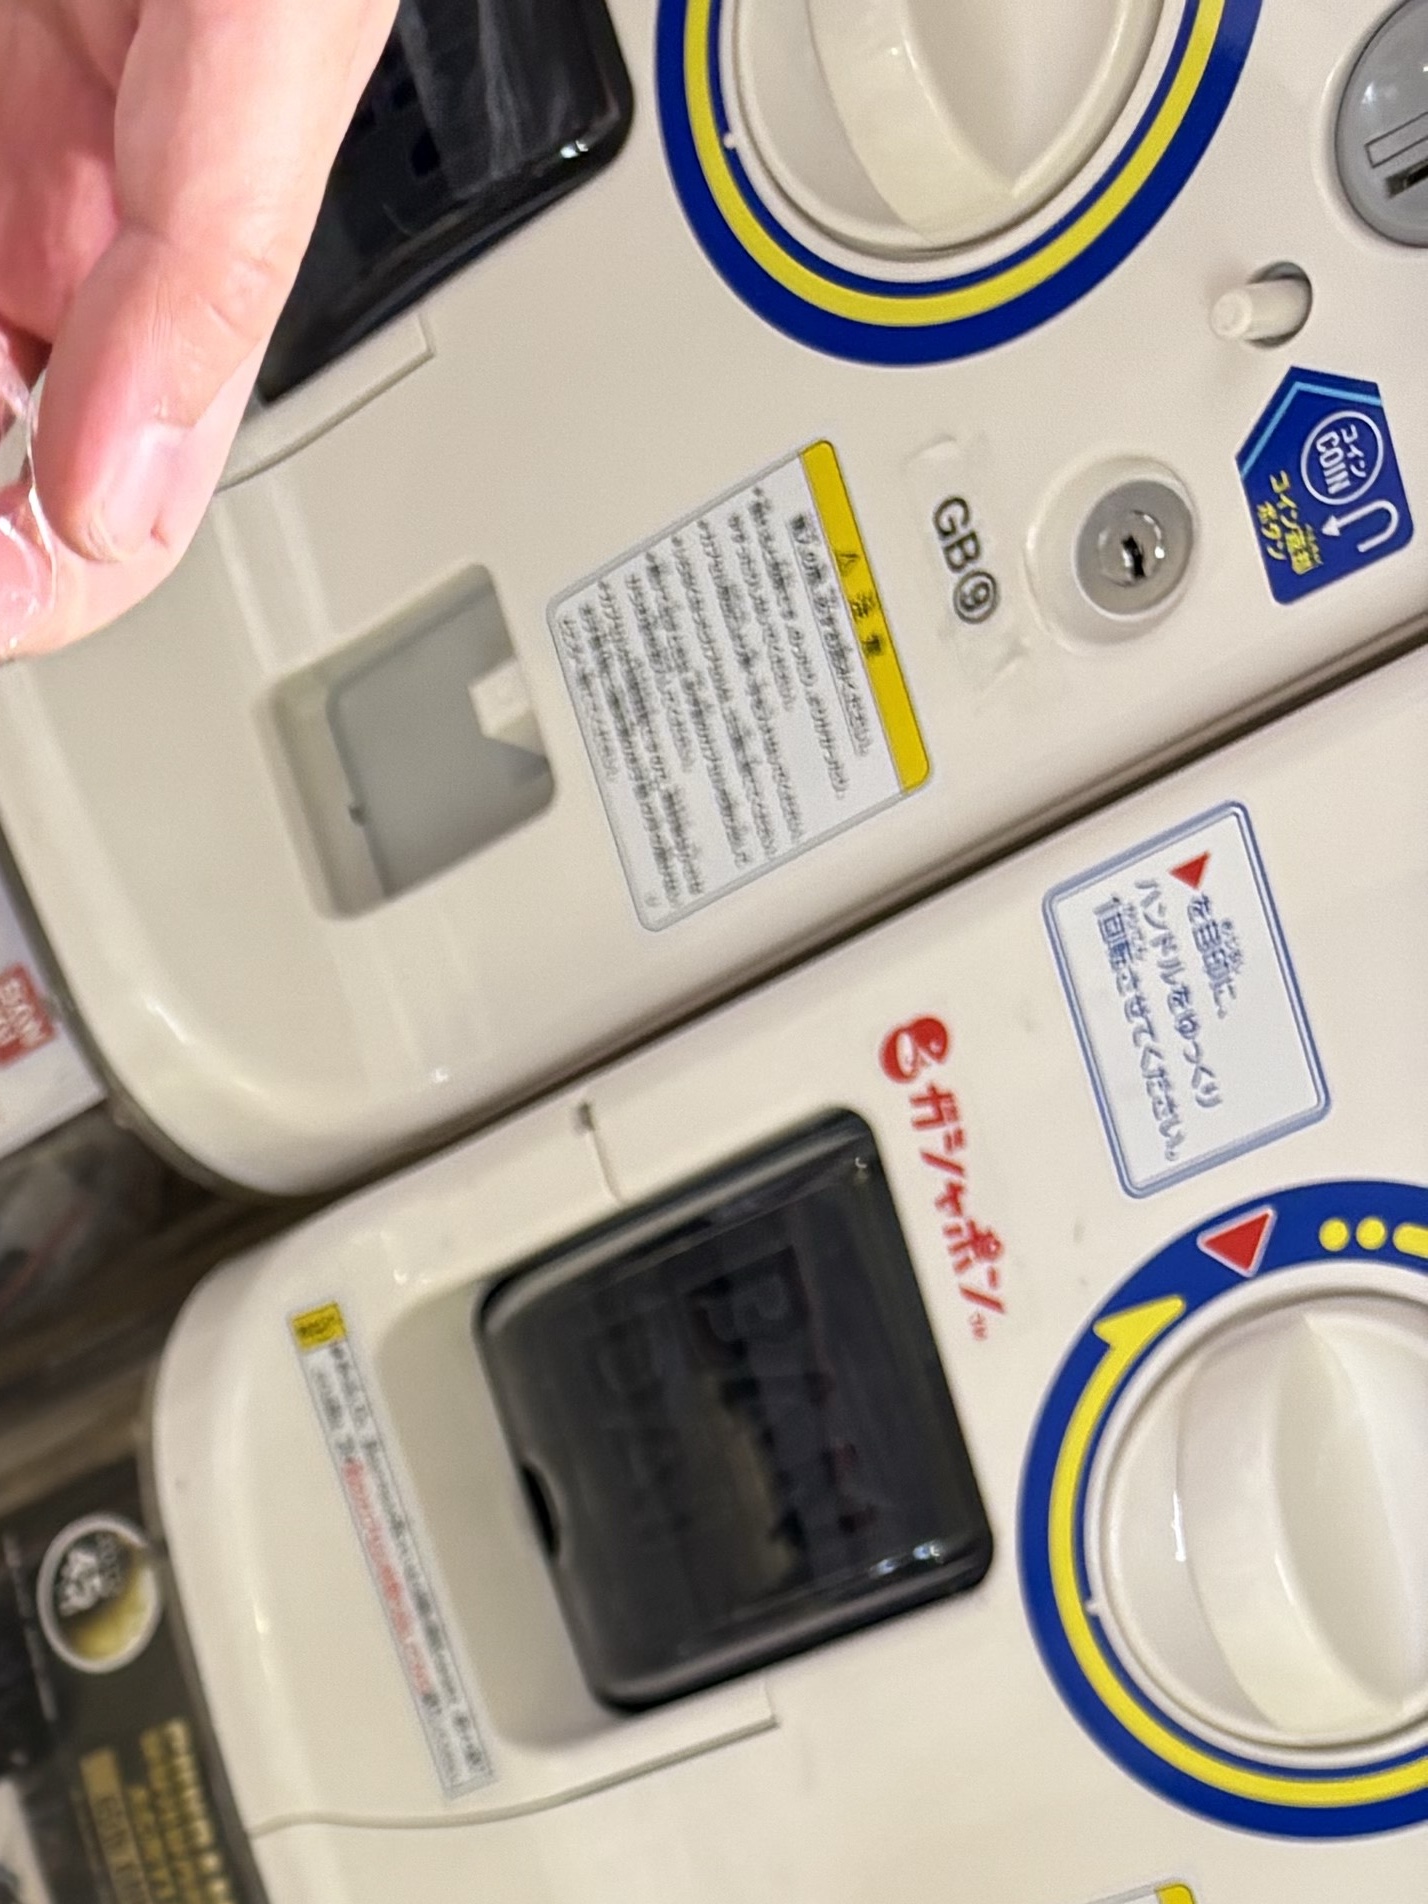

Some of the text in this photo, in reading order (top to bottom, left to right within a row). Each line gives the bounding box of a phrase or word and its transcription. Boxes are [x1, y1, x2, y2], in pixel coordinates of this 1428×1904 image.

[1313, 429, 1351, 494] COIN
[1339, 422, 1368, 479] コイン
[1253, 500, 1288, 563] ボタン
[1268, 469, 1316, 576] コイン返却
[1131, 875, 1224, 1111] ハンドルをゆっくり
[1182, 892, 1243, 1020] を目印に。
[1090, 894, 1195, 1163] 1回転させてください。
[908, 1080, 1010, 1320] ガシャポン
